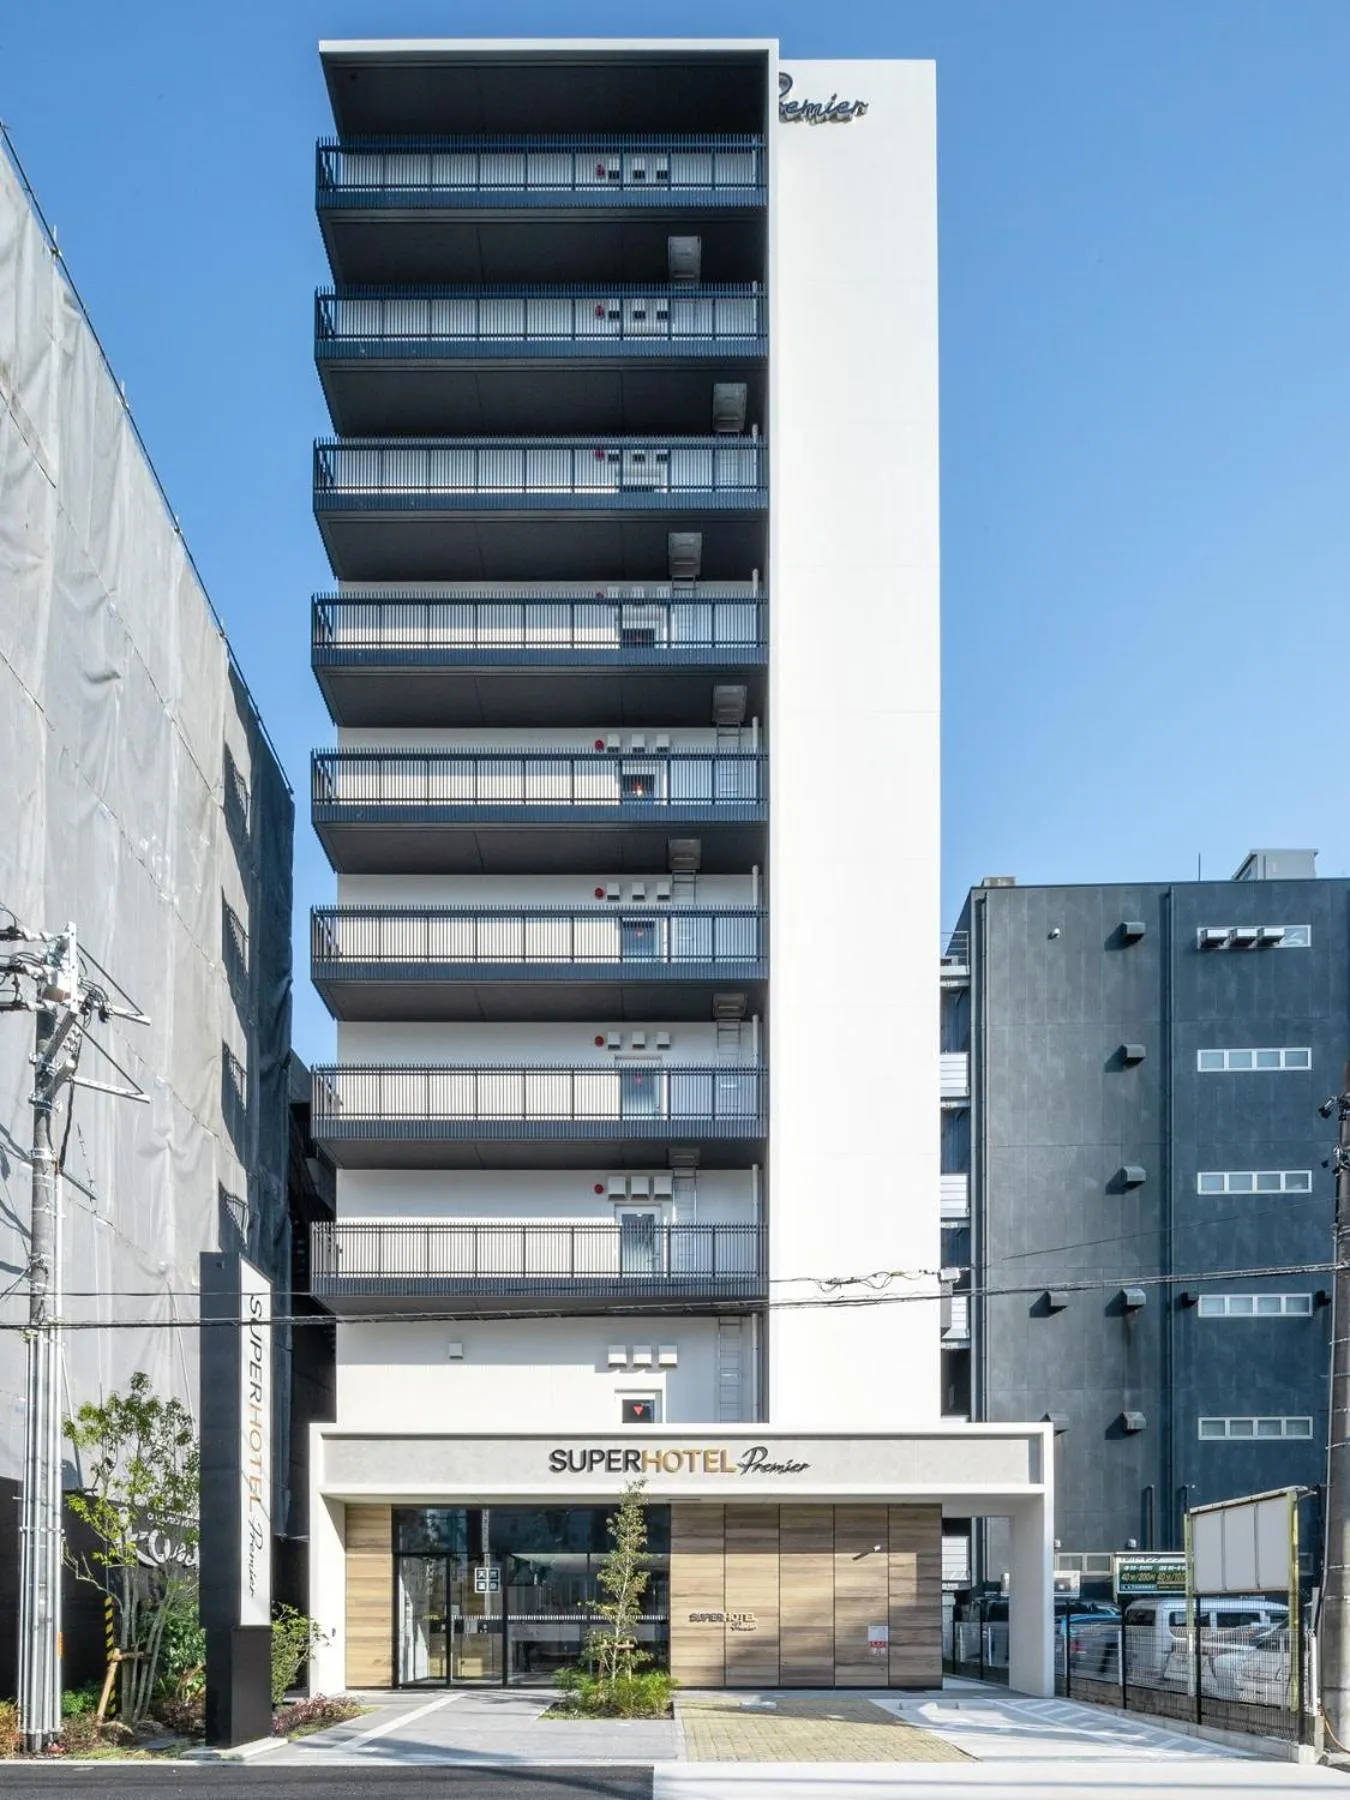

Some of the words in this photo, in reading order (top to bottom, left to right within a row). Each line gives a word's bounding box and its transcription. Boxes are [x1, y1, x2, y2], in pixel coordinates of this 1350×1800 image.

[779, 71, 869, 120] emier
[737, 1446, 811, 1475] Premier
[248, 1517, 264, 1598] Premier
